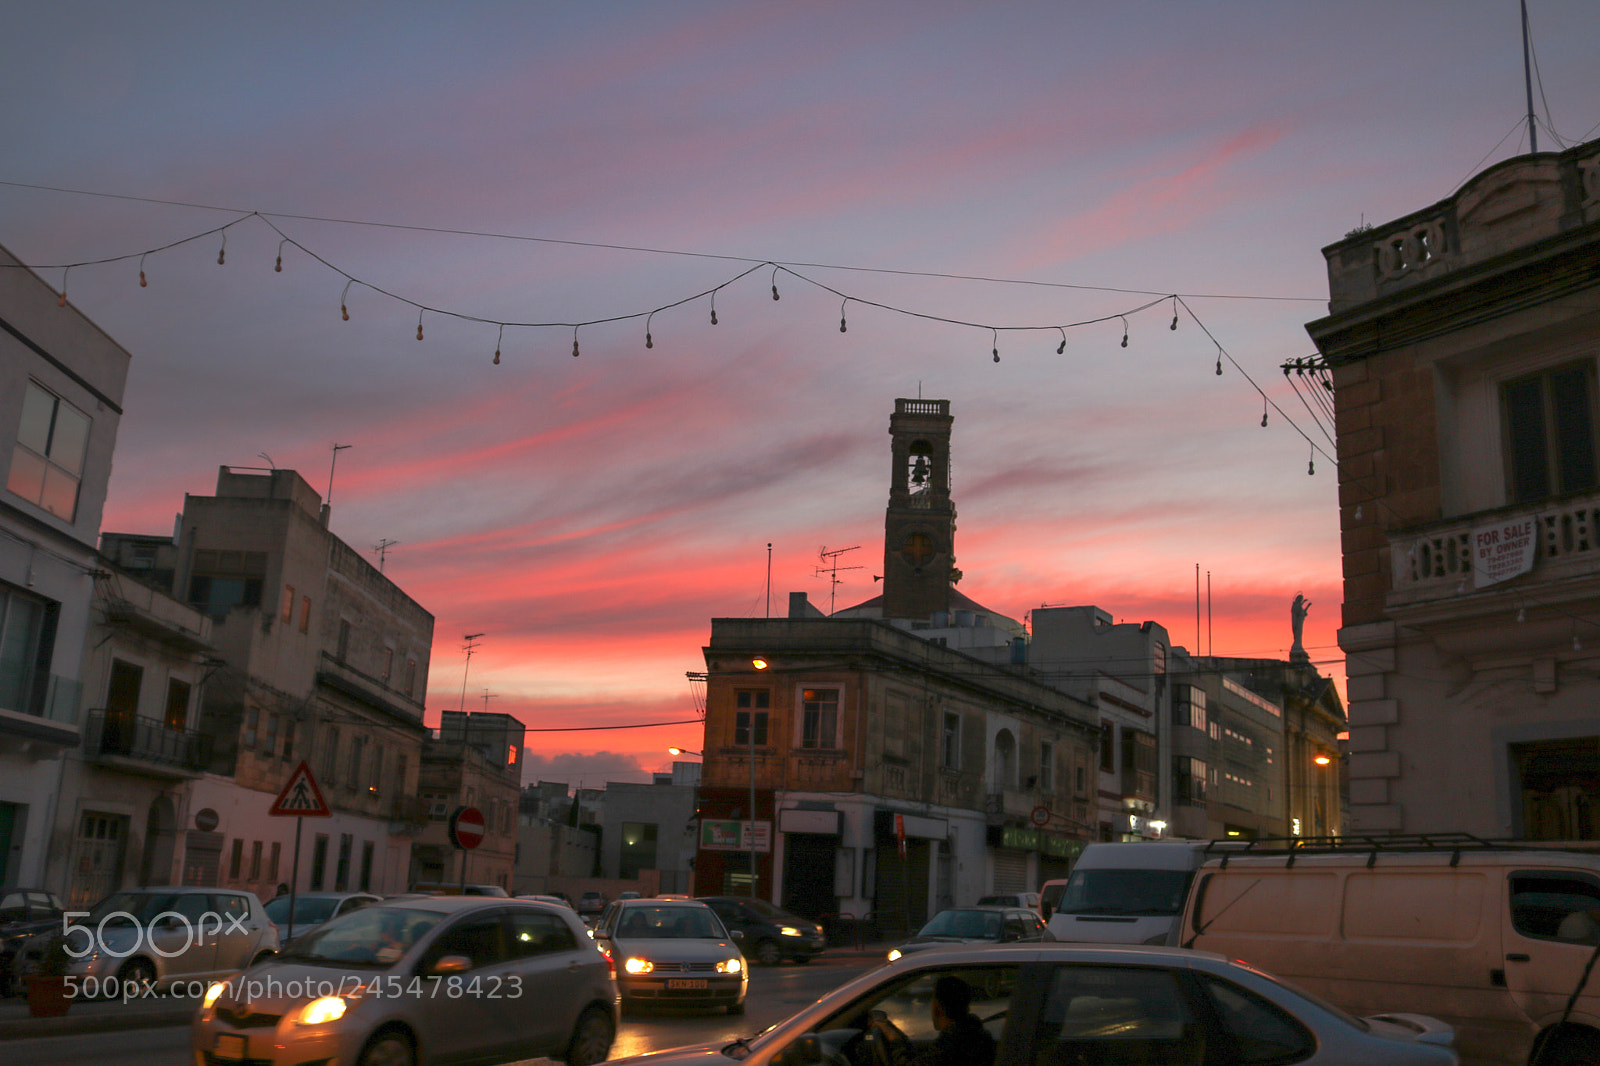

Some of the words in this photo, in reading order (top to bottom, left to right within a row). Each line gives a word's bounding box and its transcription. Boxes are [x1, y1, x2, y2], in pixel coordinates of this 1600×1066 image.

[1477, 530, 1499, 547] FOR
[1504, 522, 1532, 540] SALE
[1480, 547, 1492, 558] BY
[1497, 537, 1530, 554] OWNER
